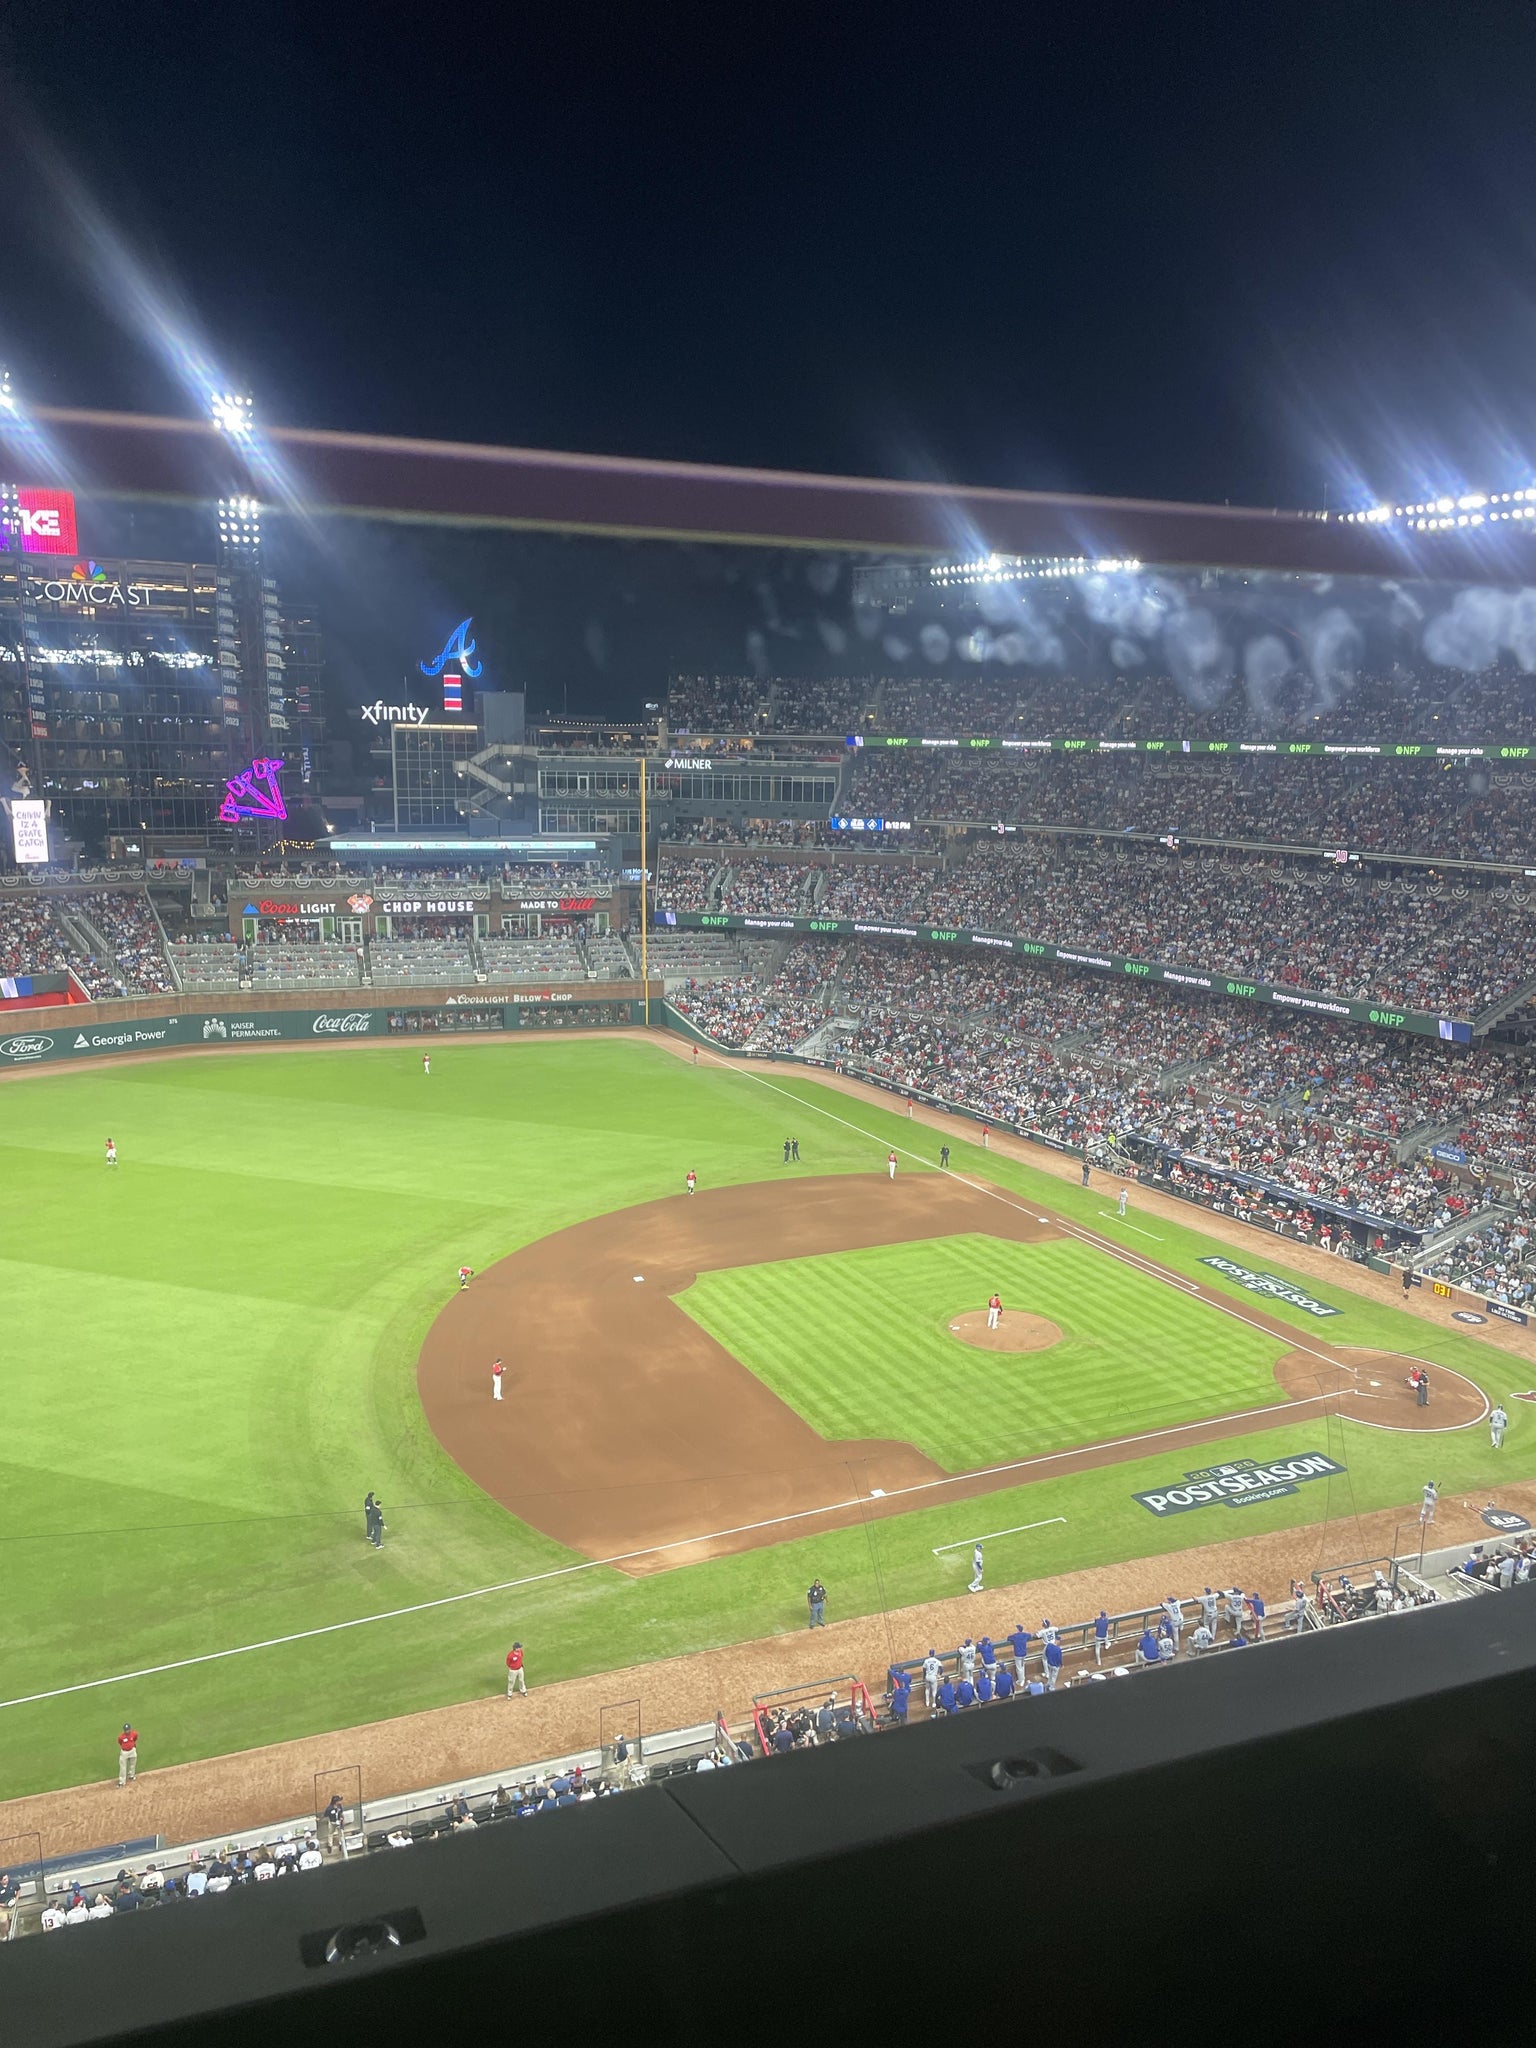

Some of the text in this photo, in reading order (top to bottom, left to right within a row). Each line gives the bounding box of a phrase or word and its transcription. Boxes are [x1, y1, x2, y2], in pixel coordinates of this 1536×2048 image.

[25, 581, 150, 606] COMCAST
[223, 684, 237, 695] 2019
[269, 686, 283, 696] 2020
[361, 700, 429, 725] xfinity
[225, 716, 240, 727] 2023
[1151, 742, 1165, 750] NFP
[1214, 743, 1229, 751] NFP
[1295, 744, 1311, 753] NFP
[1403, 746, 1421, 755] NFP
[1509, 748, 1529, 757] NFP
[674, 758, 712, 770] MILNER
[18, 838, 45, 847] CATCH
[259, 900, 336, 914] Coors LIGHT
[383, 901, 474, 913] CHOP HOUSE
[520, 897, 595, 912] MADE TO Chill
[709, 917, 729, 926] NFP
[744, 918, 794, 928] Manage your risks
[818, 922, 839, 932] NFP
[854, 924, 918, 936] Empower your workforce
[939, 931, 958, 941] NFP
[972, 935, 993, 945] Manage
[1029, 944, 1045, 955] NFP
[1056, 949, 1112, 967] Empower your workforce
[1132, 964, 1150, 976] NFP
[1163, 970, 1212, 987] Manage your risks
[1235, 984, 1256, 997] NFP
[457, 992, 573, 1005] Coors LIGHT BELOW CHOP
[1272, 991, 1350, 1015] Empower your workforce
[1379, 1013, 1405, 1026] NFP
[231, 1022, 255, 1030] KAISER
[91, 1029, 166, 1047] Georgia Power
[9, 1038, 45, 1054] Ford
[1436, 1150, 1460, 1162] GEICO
[1203, 1257, 1337, 1315] POSTSEASON
[1142, 1456, 1337, 1512] POSTSEASON
[1232, 1487, 1288, 1504] Booking.com
[929, 1663, 935, 1671] 6
[44, 1918, 54, 1928] 13
